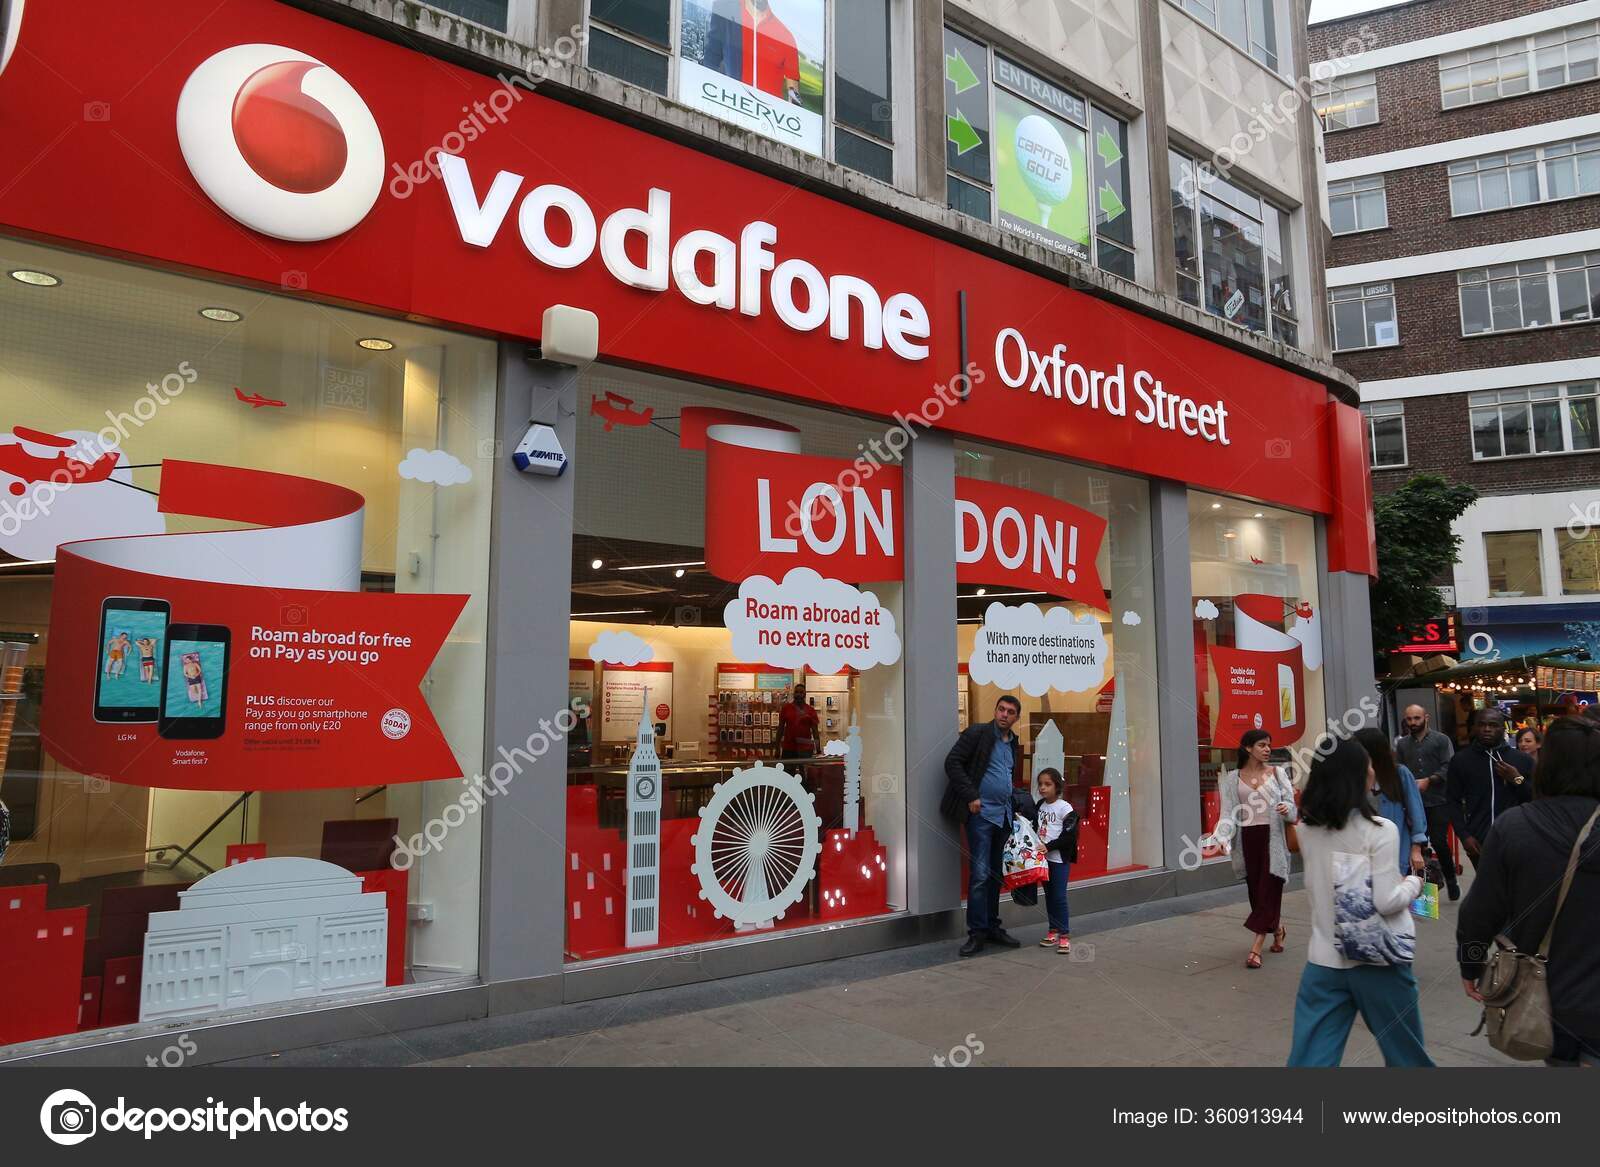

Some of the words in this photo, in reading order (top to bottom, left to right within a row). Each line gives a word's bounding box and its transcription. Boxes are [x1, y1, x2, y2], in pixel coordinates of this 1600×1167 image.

[1000, 63, 1083, 119] ENTRANCE
[1027, 160, 1061, 183] GOLF
[1001, 218, 1012, 229] The
[1013, 223, 1035, 240] World's
[1036, 233, 1054, 246] Finest
[1055, 240, 1067, 252] Golf
[1068, 245, 1087, 260] Brands
[436, 151, 930, 361] vodafone
[994, 327, 1126, 417] Oxford
[1133, 370, 1231, 445] Street
[539, 450, 563, 462] MITIE
[757, 478, 895, 557] LON
[955, 499, 1079, 584] DON!
[746, 597, 798, 621] Roam
[802, 601, 861, 625] abroad
[864, 607, 880, 626] at
[251, 626, 299, 643] Roam
[302, 629, 356, 645] abroad
[359, 631, 380, 646] for
[383, 633, 412, 647] free
[758, 628, 781, 646] no
[786, 629, 830, 649] extra
[835, 632, 870, 650] cost
[986, 631, 1010, 646] With
[1011, 635, 1037, 647] more
[1038, 633, 1095, 649] destinations
[250, 646, 271, 658] on
[275, 645, 304, 663] Pay
[307, 649, 325, 660] as
[328, 649, 356, 664] you
[360, 651, 379, 665] go
[986, 650, 1010, 665] than
[1012, 653, 1030, 668] any
[1032, 651, 1057, 665] other
[1059, 652, 1096, 666] network
[246, 695, 275, 706] PLUS
[277, 696, 317, 706] discover
[318, 698, 334, 706] our
[246, 709, 264, 720] Pay
[265, 711, 276, 719] as
[278, 711, 296, 721] you
[298, 711, 310, 721] go
[312, 709, 368, 721] smartphone
[244, 722, 272, 732] range
[274, 721, 298, 730] from
[300, 721, 321, 732] only
[322, 721, 341, 731] £20
